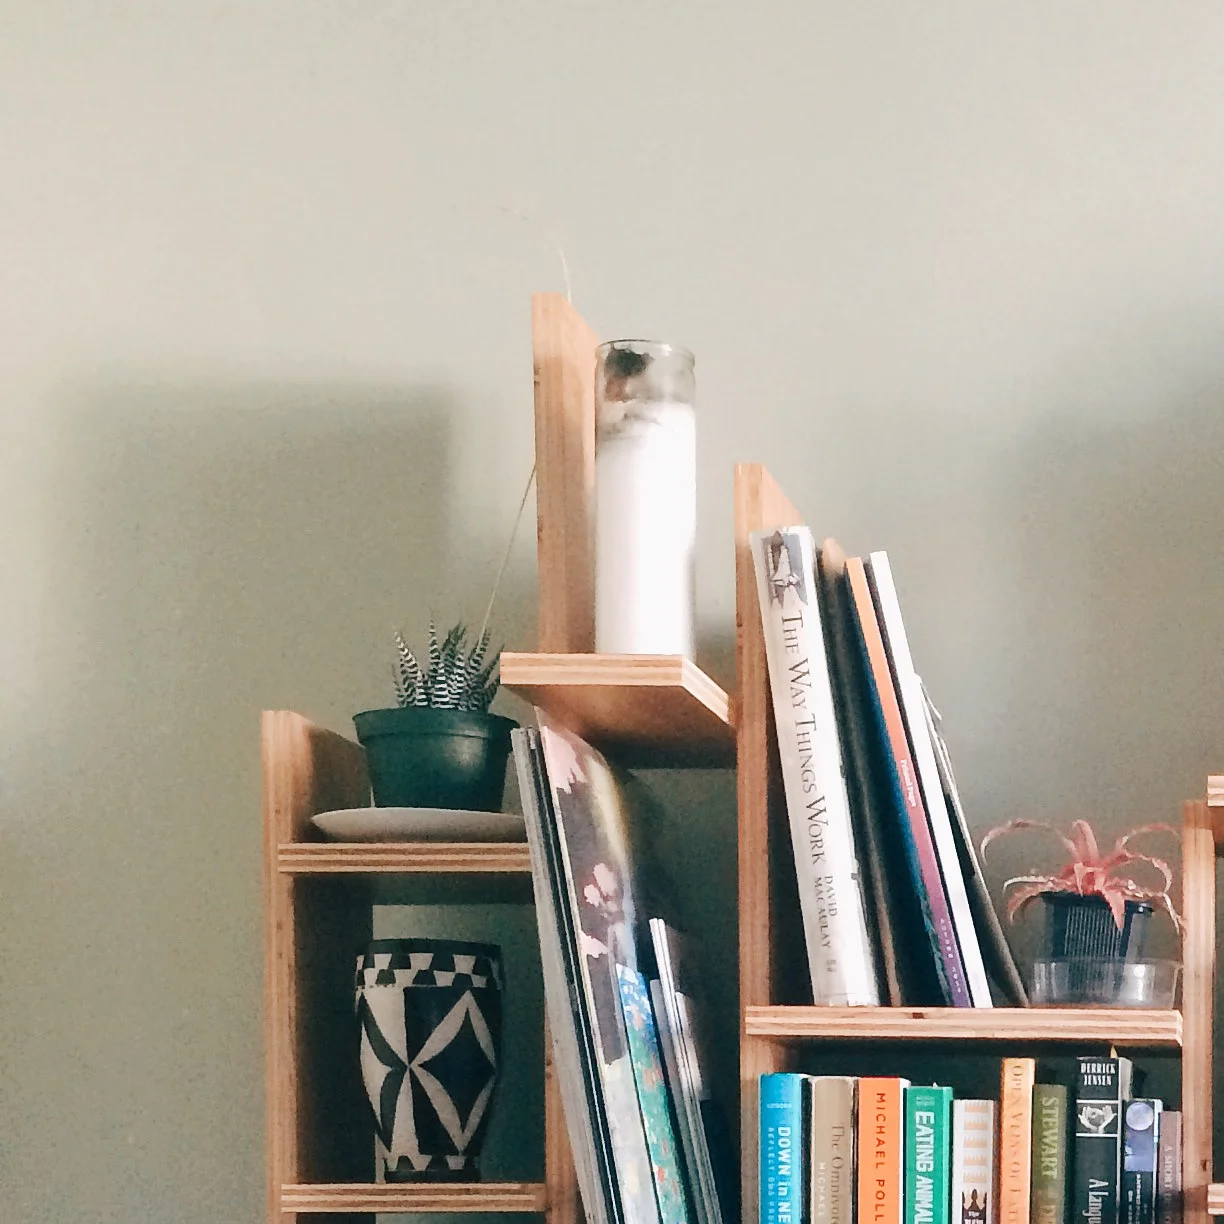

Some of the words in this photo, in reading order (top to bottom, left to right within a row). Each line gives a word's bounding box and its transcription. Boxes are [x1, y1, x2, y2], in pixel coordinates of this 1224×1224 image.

[782, 610, 803, 654] THE
[786, 658, 810, 710] WAY
[794, 713, 817, 793] THINGS
[805, 795, 829, 865] WORK
[824, 874, 837, 917] DAVID
[1010, 1065, 1023, 1103] OPEN
[1080, 1063, 1115, 1074] DERRICK
[1084, 1075, 1112, 1086] JENSEN
[777, 1126, 791, 1175] DOWN
[830, 1125, 845, 1150] The
[874, 1092, 887, 1169] MICHAEL
[915, 1111, 934, 1172] EATING
[1040, 1096, 1058, 1180] STEWART
[777, 1181, 791, 1197] in
[1088, 1178, 1105, 1188] A
